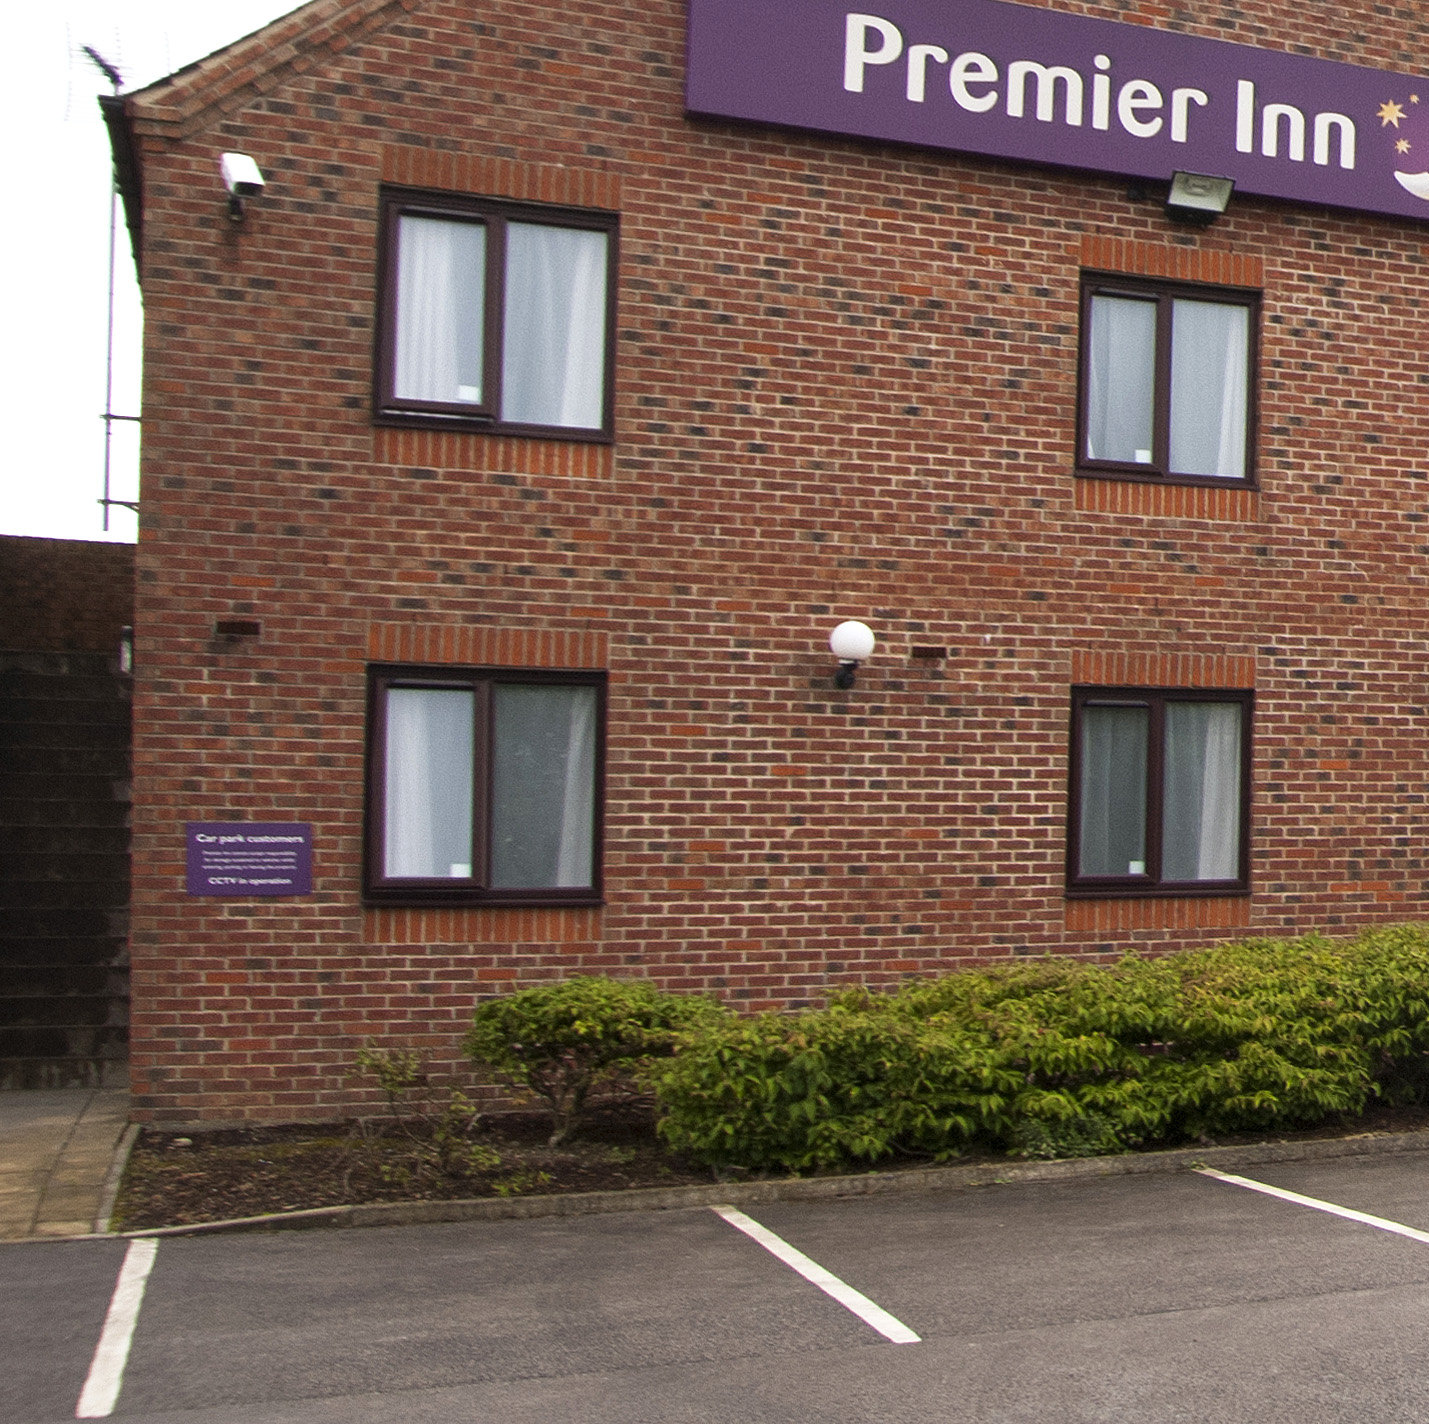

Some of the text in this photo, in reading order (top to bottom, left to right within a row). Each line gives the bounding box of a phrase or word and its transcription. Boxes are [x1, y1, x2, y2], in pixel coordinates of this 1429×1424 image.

[844, 11, 1358, 171] Premier Inn
[195, 833, 305, 845] Car park customers
[208, 876, 238, 885] CCTV
